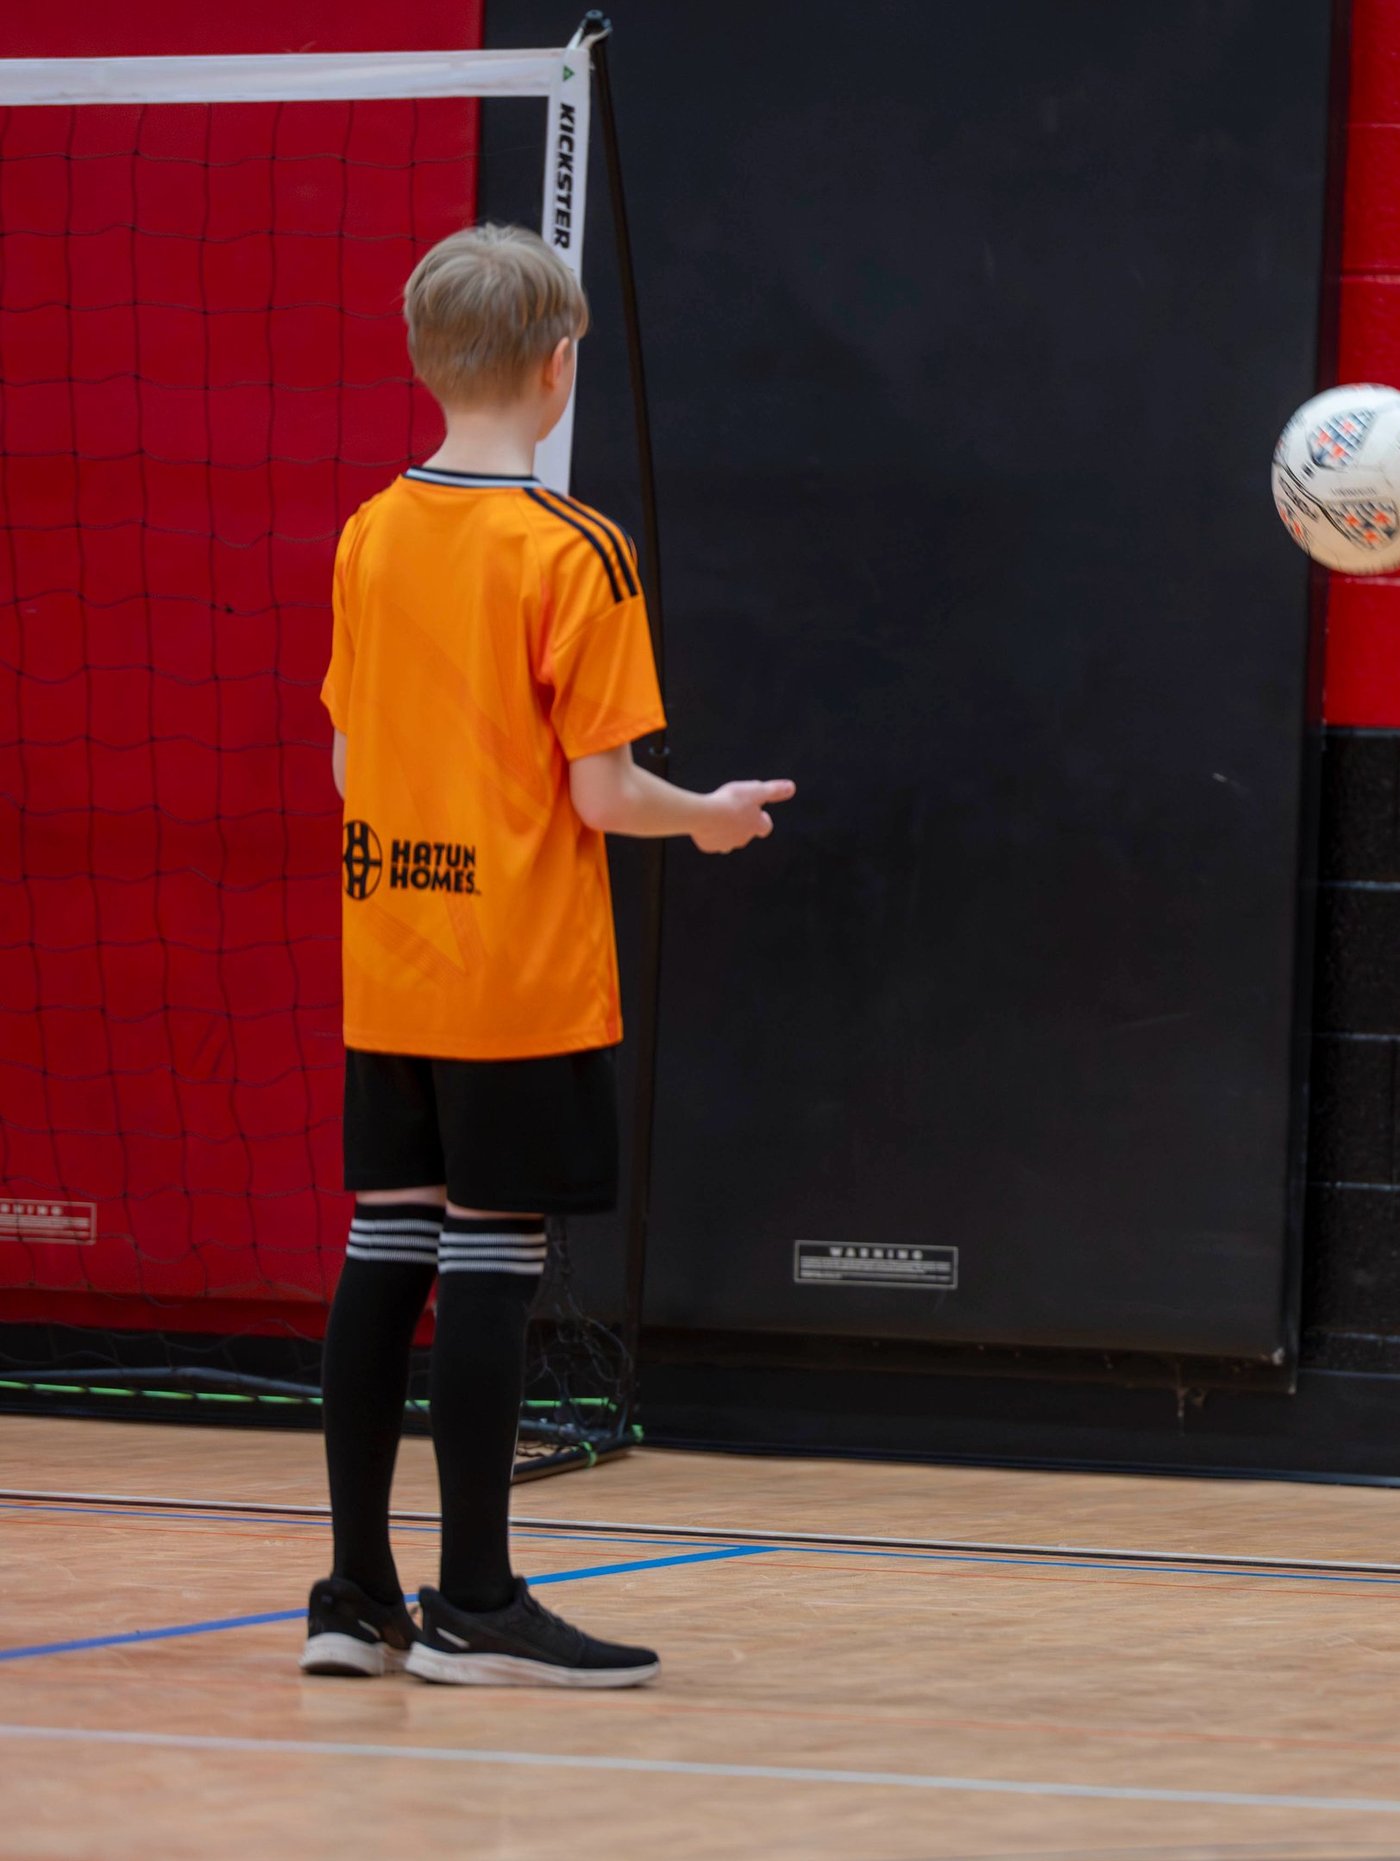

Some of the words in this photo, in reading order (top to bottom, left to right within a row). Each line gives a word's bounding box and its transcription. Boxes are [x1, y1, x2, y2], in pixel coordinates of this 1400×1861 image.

[553, 102, 576, 250] KICKSTER
[391, 840, 476, 869] HATUN
[389, 867, 476, 895] HOMES
